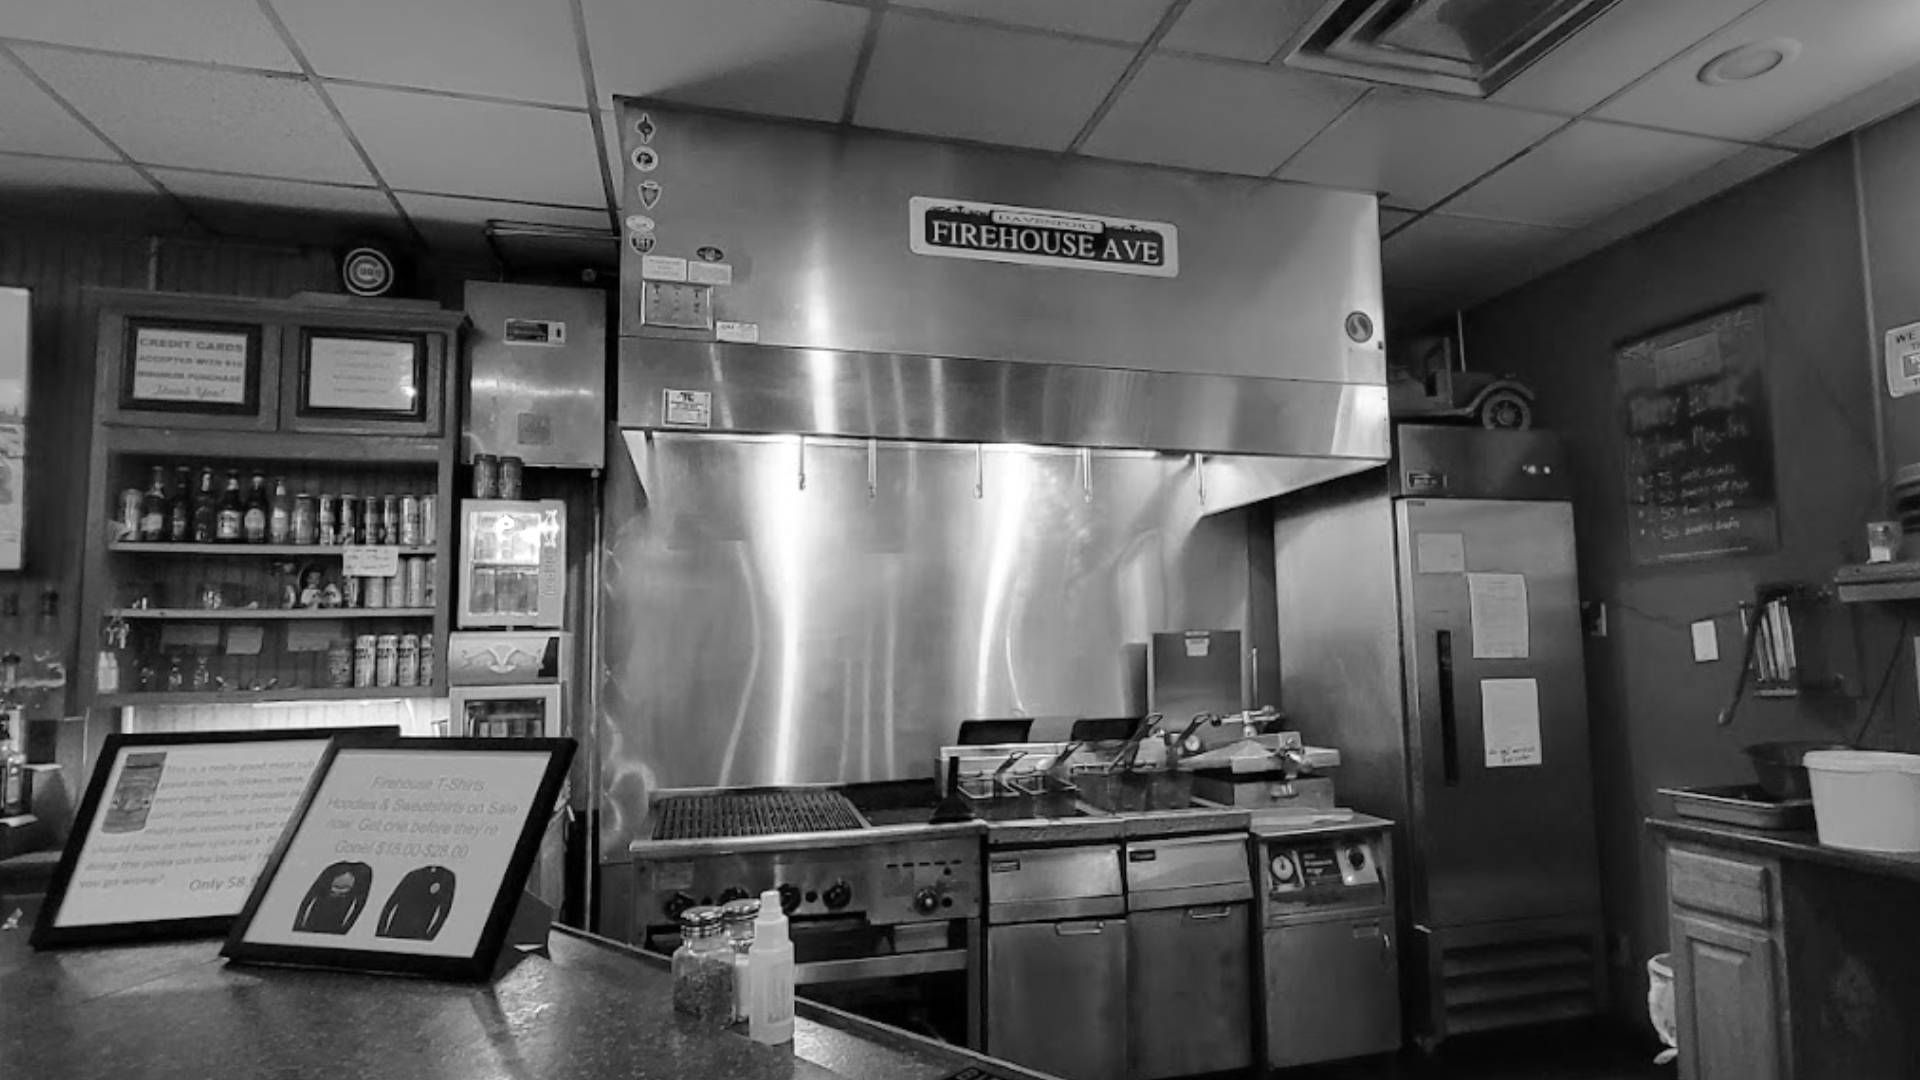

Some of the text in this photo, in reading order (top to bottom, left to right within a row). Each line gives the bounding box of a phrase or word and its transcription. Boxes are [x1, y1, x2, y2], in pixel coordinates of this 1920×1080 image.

[932, 220, 1160, 264] FIREHOUSE AVE
[140, 338, 244, 353] CREDIT CARDS
[370, 776, 435, 791] Firehouse
[487, 801, 519, 815] Sale
[410, 819, 453, 835] before
[188, 878, 224, 892] Only
